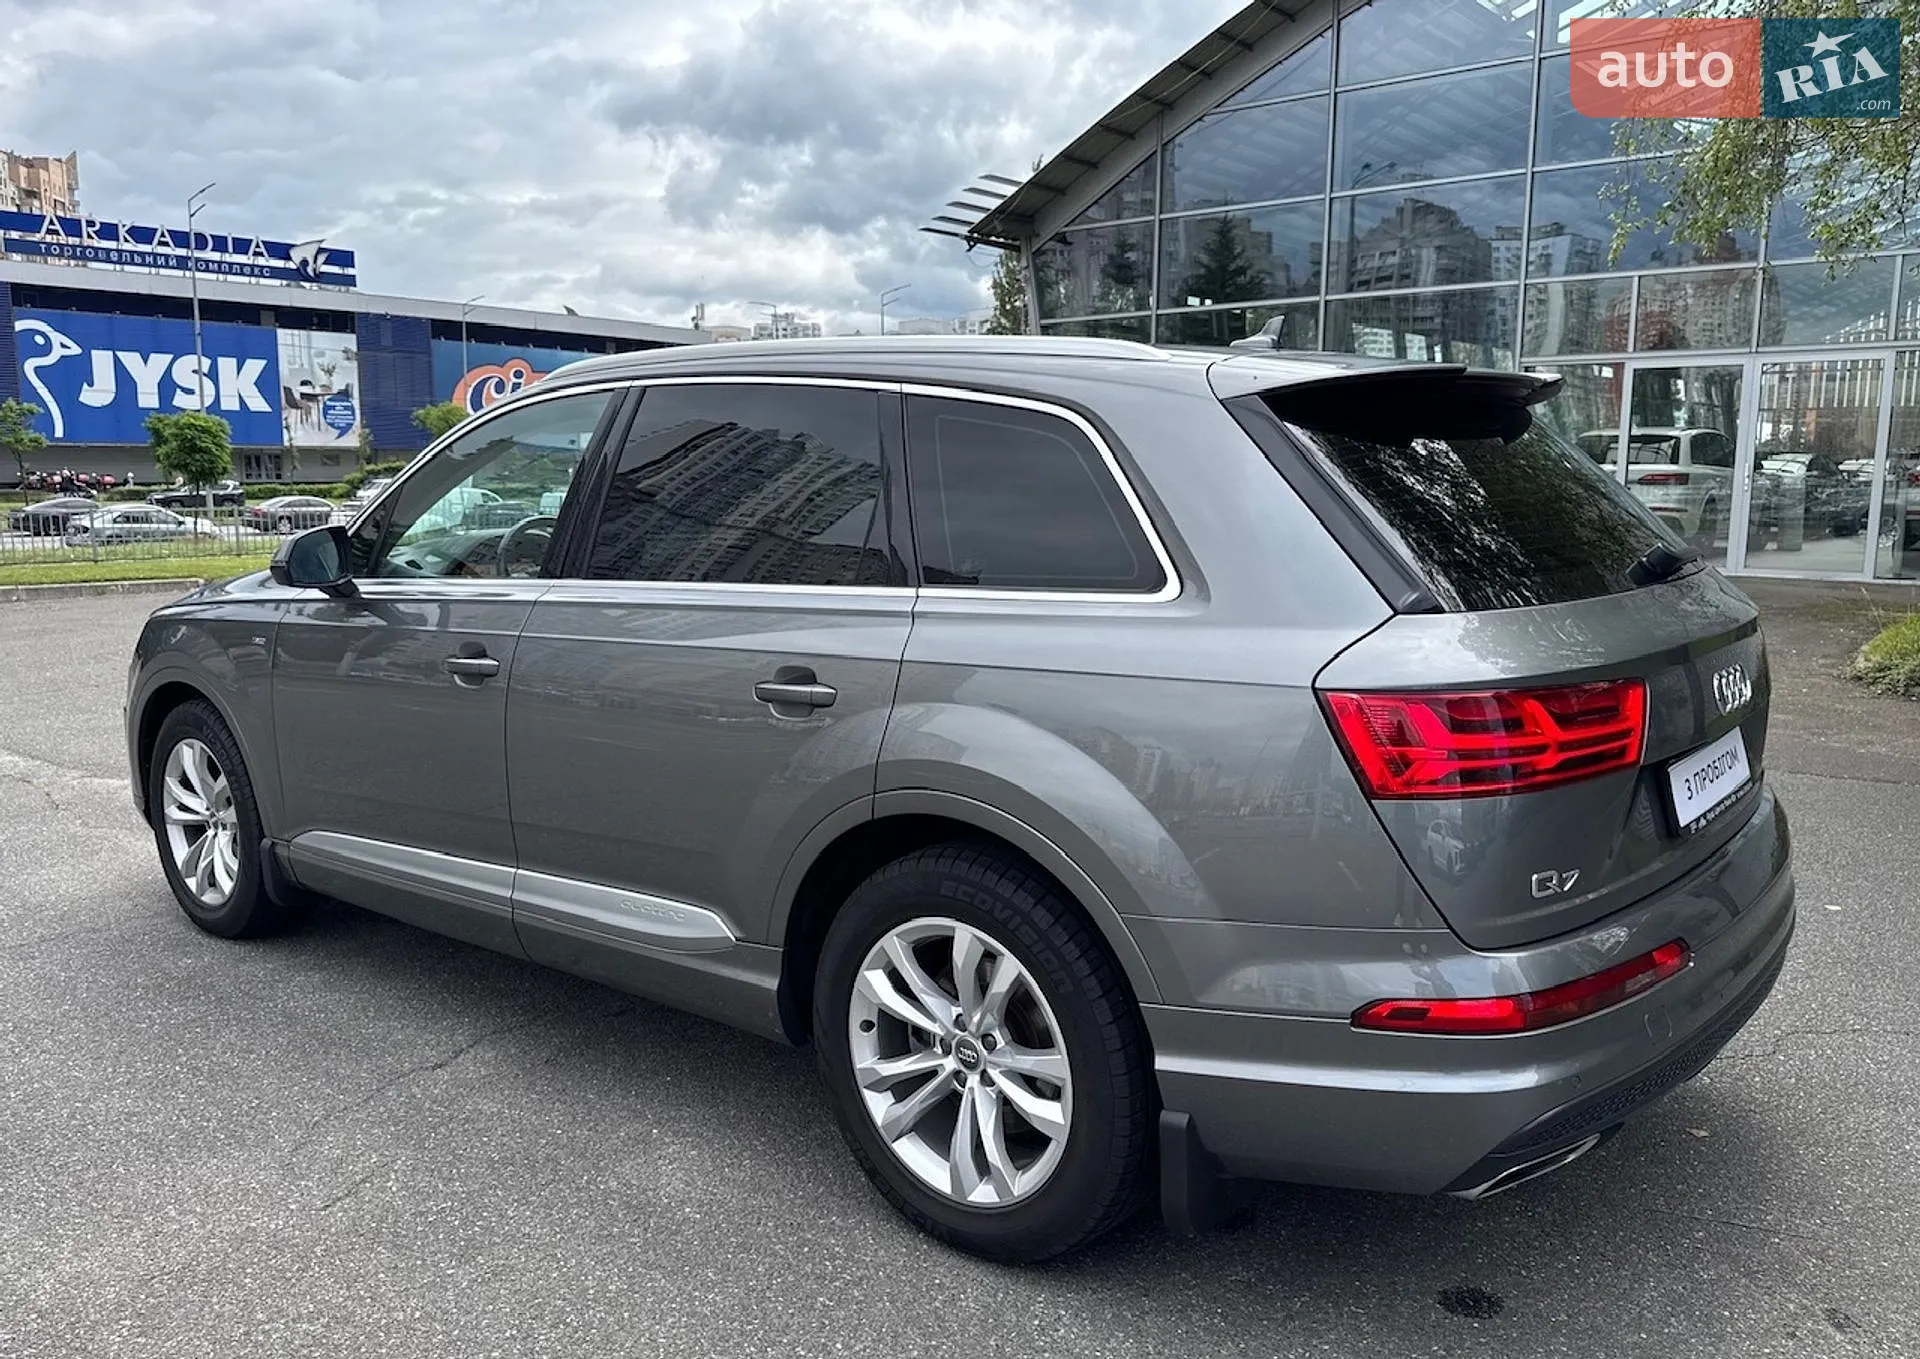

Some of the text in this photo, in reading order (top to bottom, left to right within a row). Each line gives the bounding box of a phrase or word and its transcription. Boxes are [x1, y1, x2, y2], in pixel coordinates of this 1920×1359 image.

[39, 212, 269, 262] ARKADIA
[78, 350, 273, 413] JYSK
[1531, 869, 1580, 898] Q7
